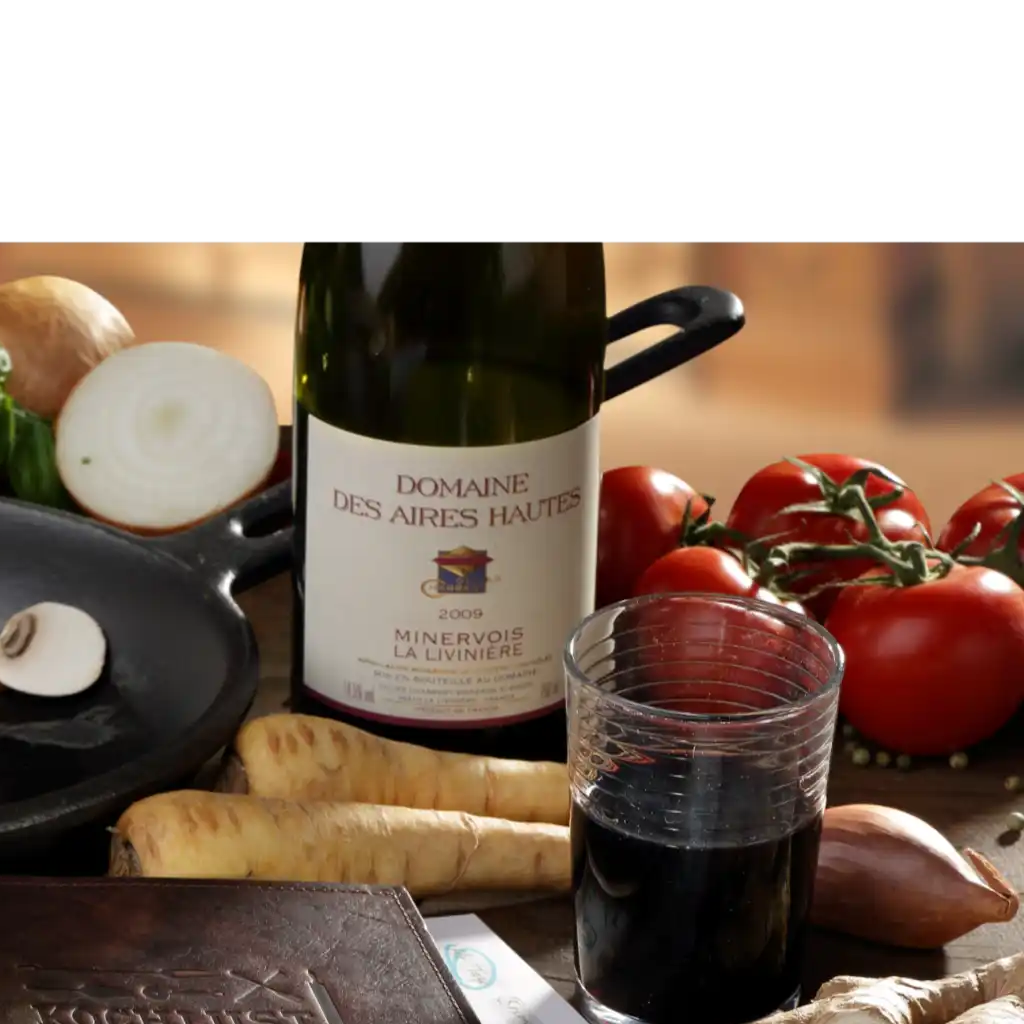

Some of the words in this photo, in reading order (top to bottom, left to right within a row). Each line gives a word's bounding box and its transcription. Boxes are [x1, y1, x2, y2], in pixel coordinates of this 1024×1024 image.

[396, 473, 529, 498] DOMAINE
[333, 488, 381, 520] DES
[389, 505, 479, 528] AIRES
[489, 487, 581, 527] HAUTES
[438, 608, 484, 621] 2009
[394, 627, 524, 646] MINERVOIS
[393, 646, 418, 660] LA
